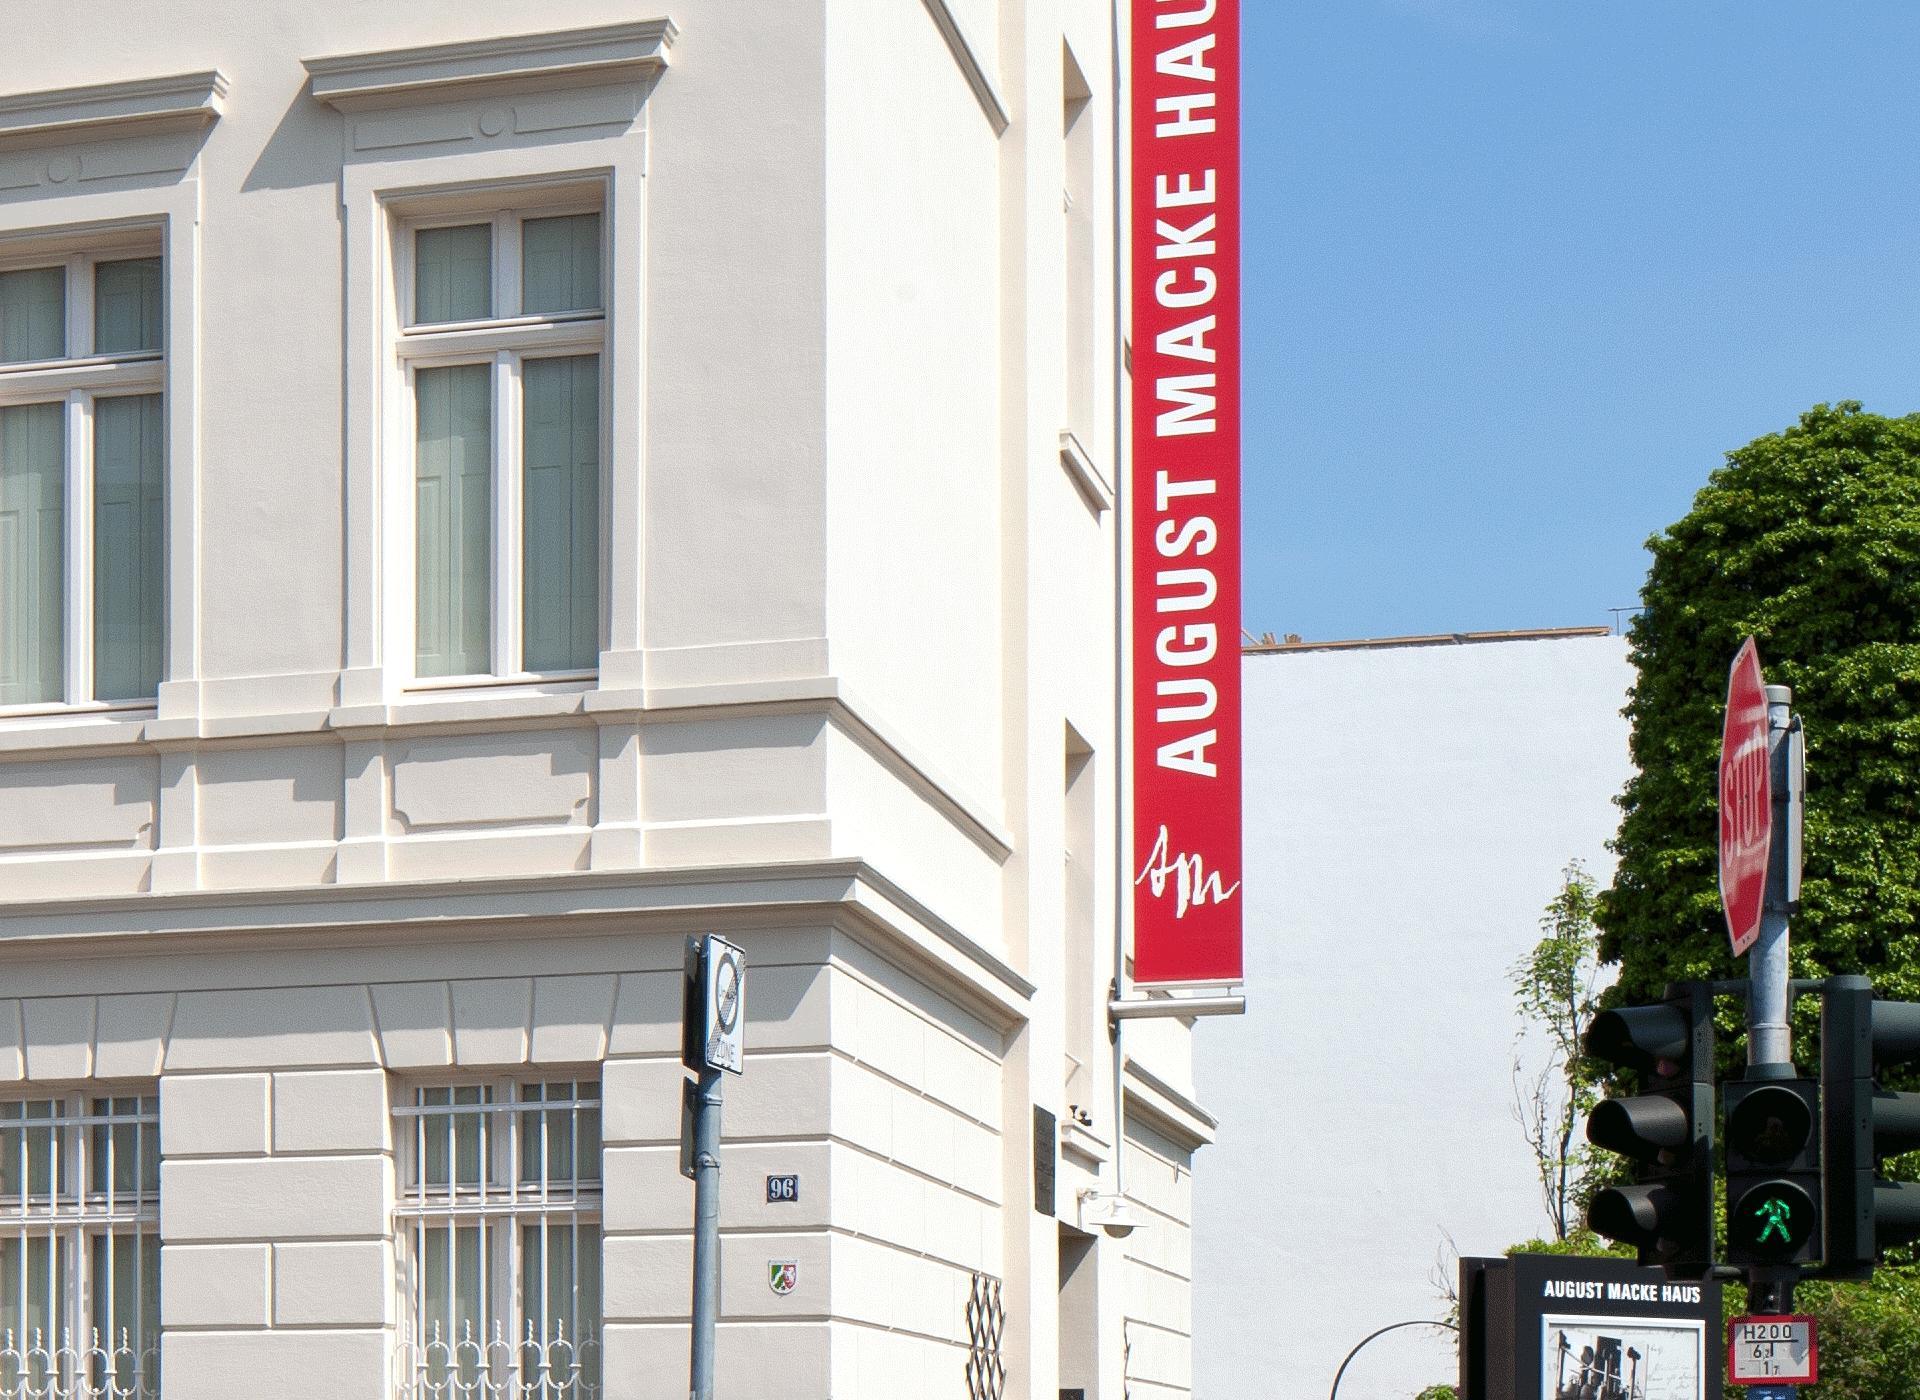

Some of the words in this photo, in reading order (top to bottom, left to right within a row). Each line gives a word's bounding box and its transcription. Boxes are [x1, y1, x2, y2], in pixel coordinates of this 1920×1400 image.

[1156, 168, 1217, 438] MACKE
[1156, 469, 1217, 778] AUGUST
[1724, 723, 1762, 868] STOP
[770, 1178, 794, 1199] 96
[1544, 1280, 1603, 1299] AUGUST
[1608, 1283, 1658, 1302] MACKE
[1662, 1285, 1700, 1304] HAUS
[1744, 1324, 1792, 1339] H200
